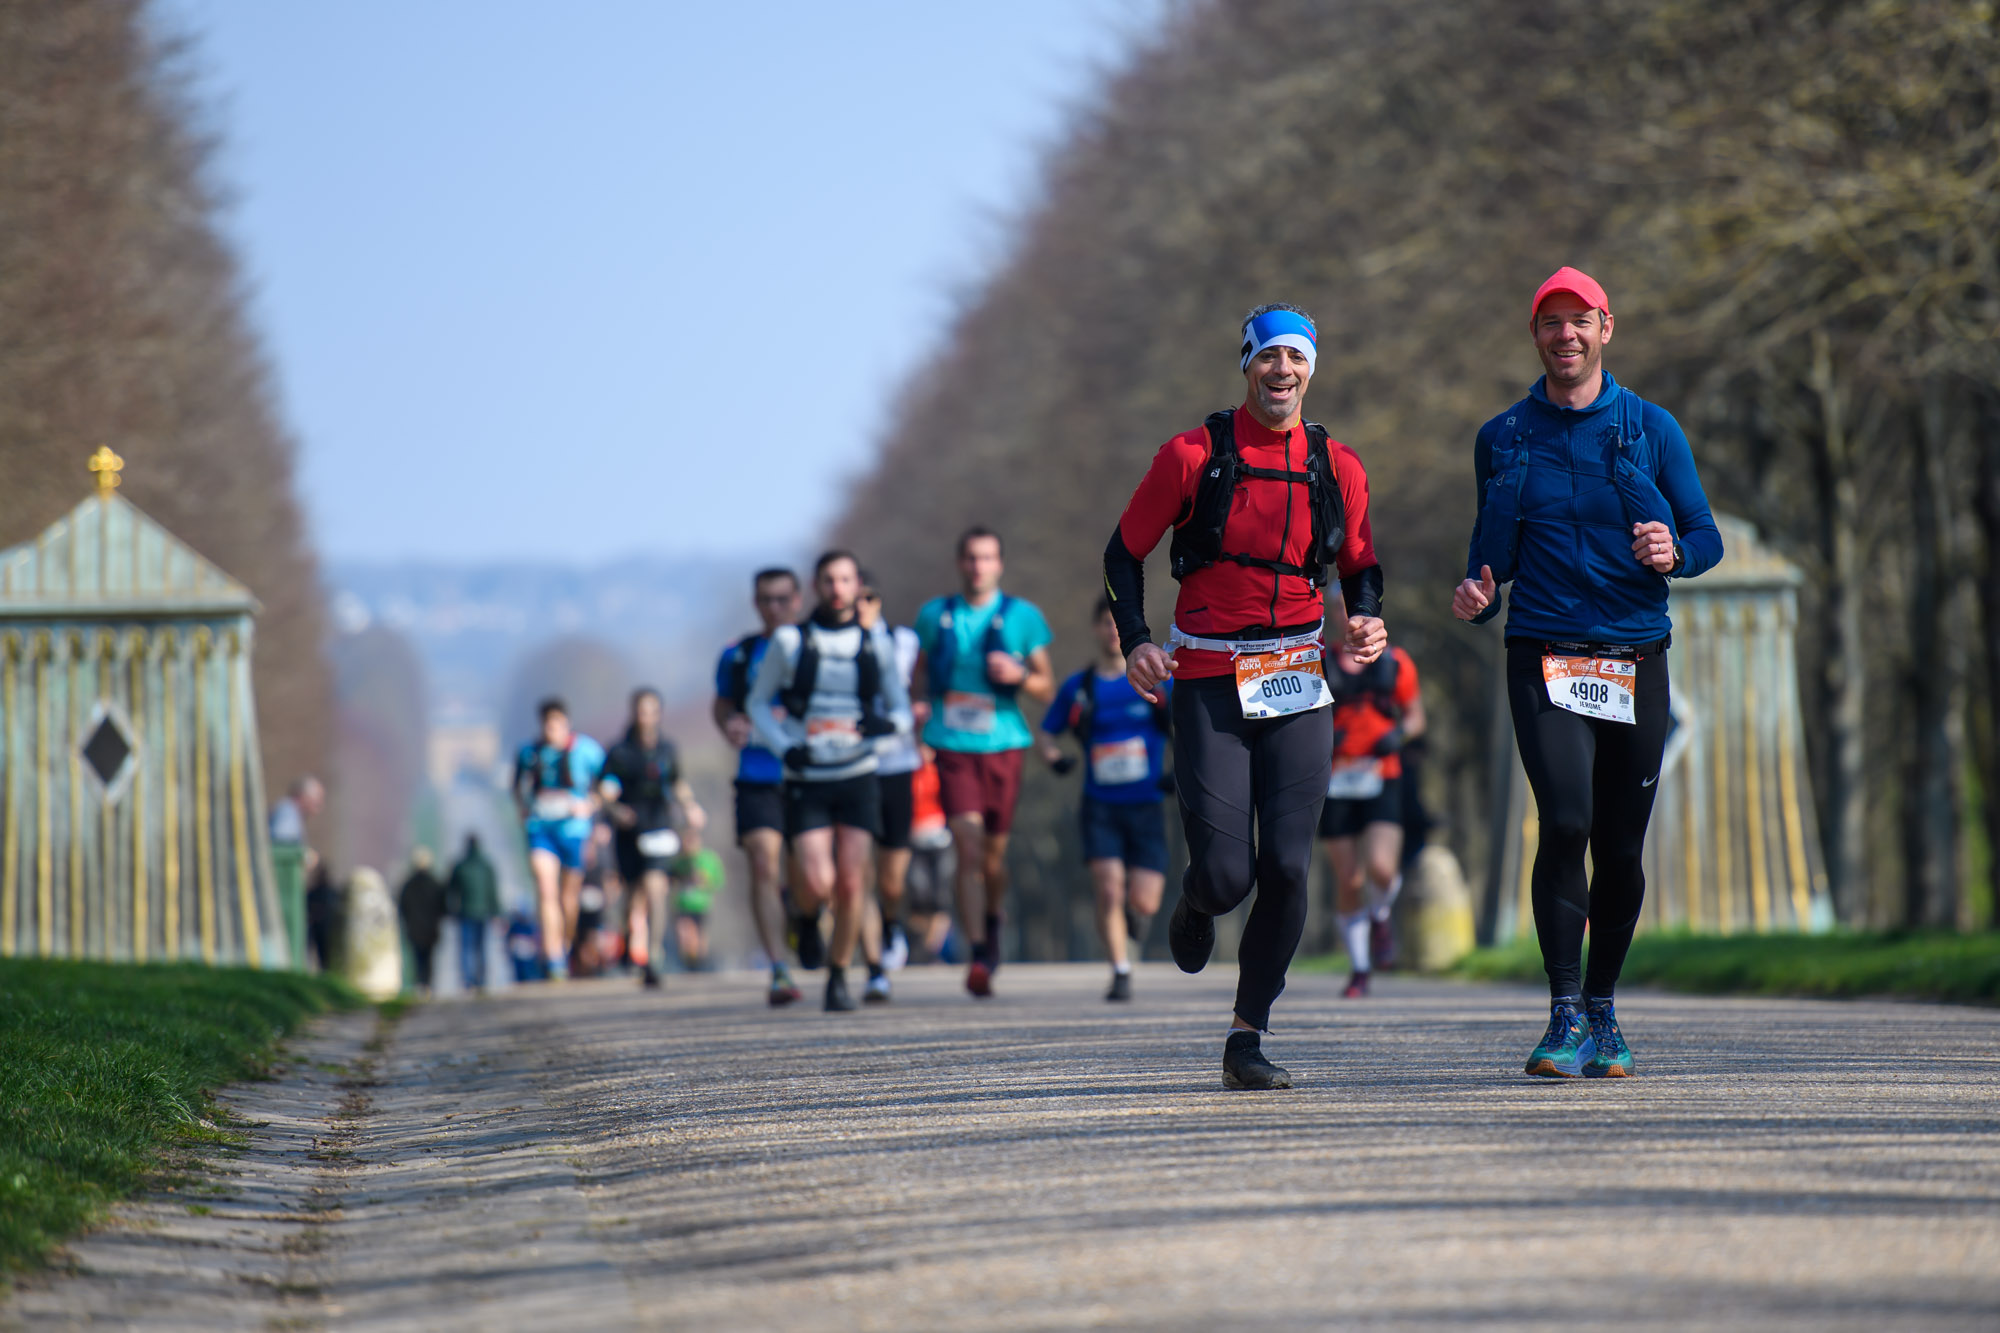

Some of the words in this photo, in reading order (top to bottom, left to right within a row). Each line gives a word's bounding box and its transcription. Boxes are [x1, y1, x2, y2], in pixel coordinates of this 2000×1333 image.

[1239, 662, 1261, 670] 45KM
[1262, 675, 1302, 698] 6000
[1569, 682, 1608, 703] 4908
[1579, 701, 1602, 711] JEROME
